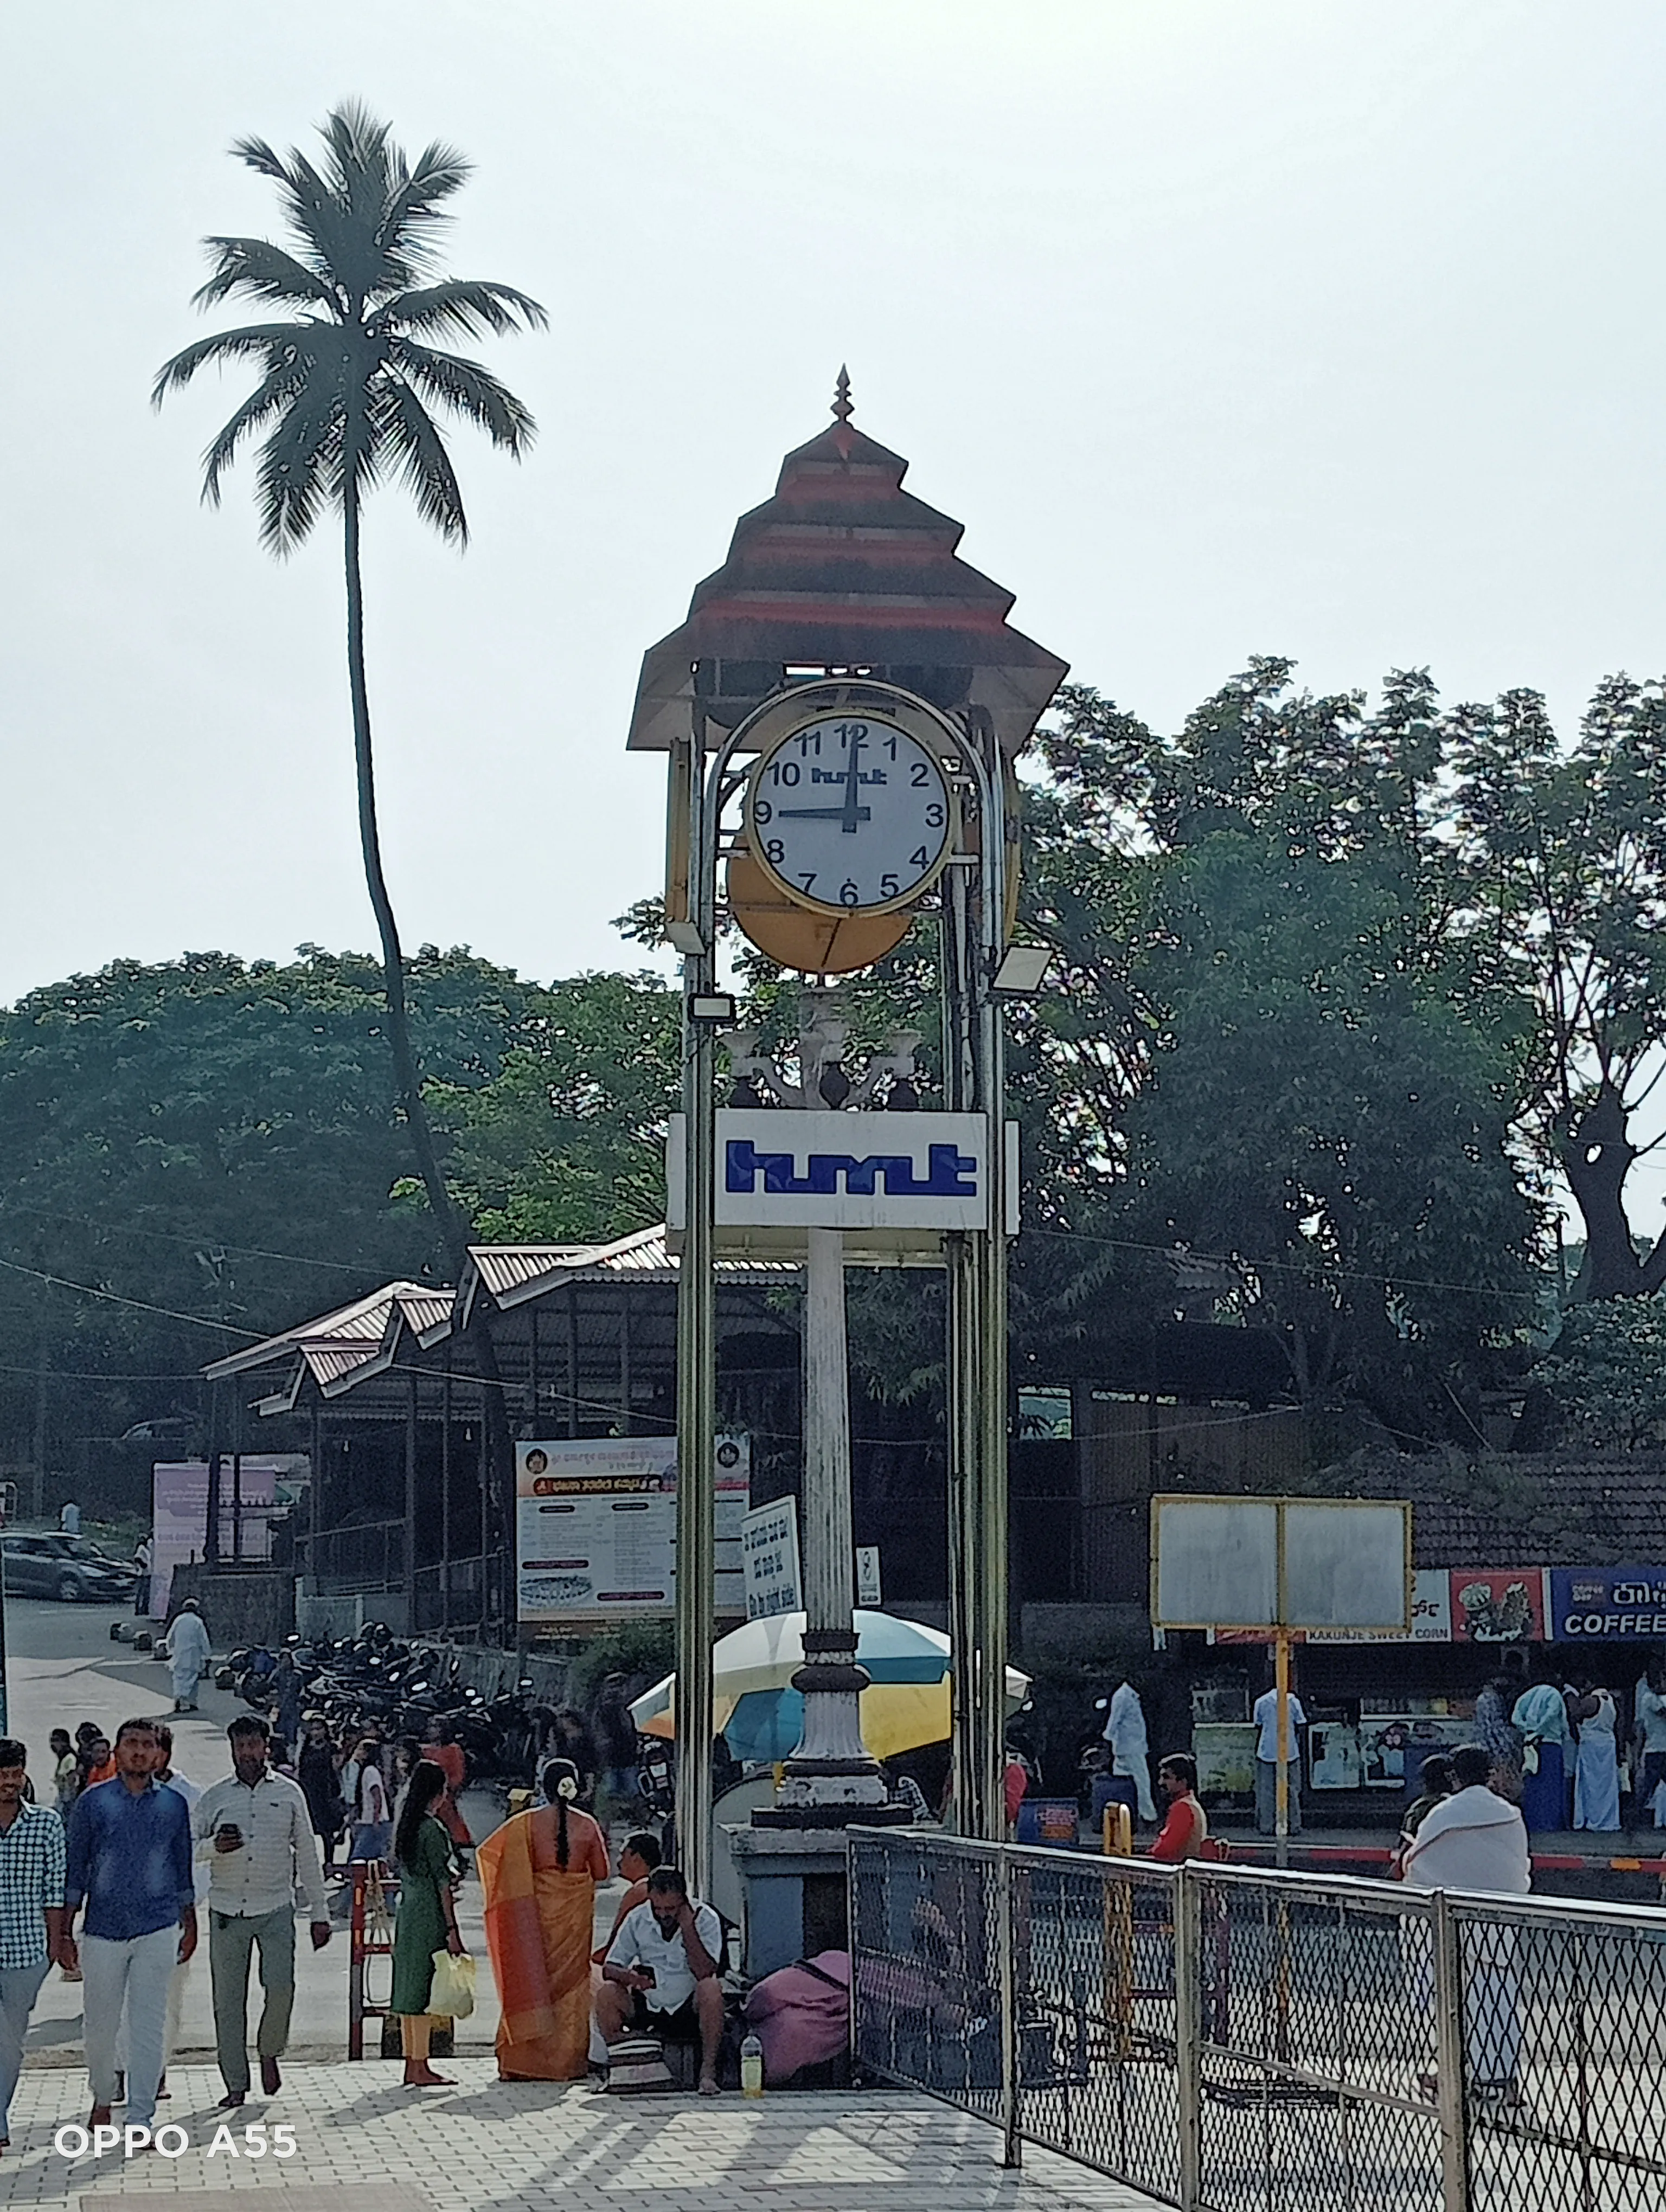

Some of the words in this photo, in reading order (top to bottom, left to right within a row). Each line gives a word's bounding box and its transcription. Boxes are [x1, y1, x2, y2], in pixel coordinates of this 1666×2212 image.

[794, 731, 821, 756] 11
[834, 723, 869, 748] 12
[883, 737, 896, 761] 1
[767, 762, 800, 786] 10
[910, 763, 930, 787] 2
[754, 801, 772, 825] 9
[925, 803, 944, 827] 3
[767, 839, 784, 863] 8
[909, 846, 930, 870] 4
[798, 873, 817, 892] 7
[840, 880, 858, 906] 6
[880, 874, 899, 898] 5
[1415, 1628, 1448, 1639] CORN
[1565, 1613, 1666, 1634] COFFEE
